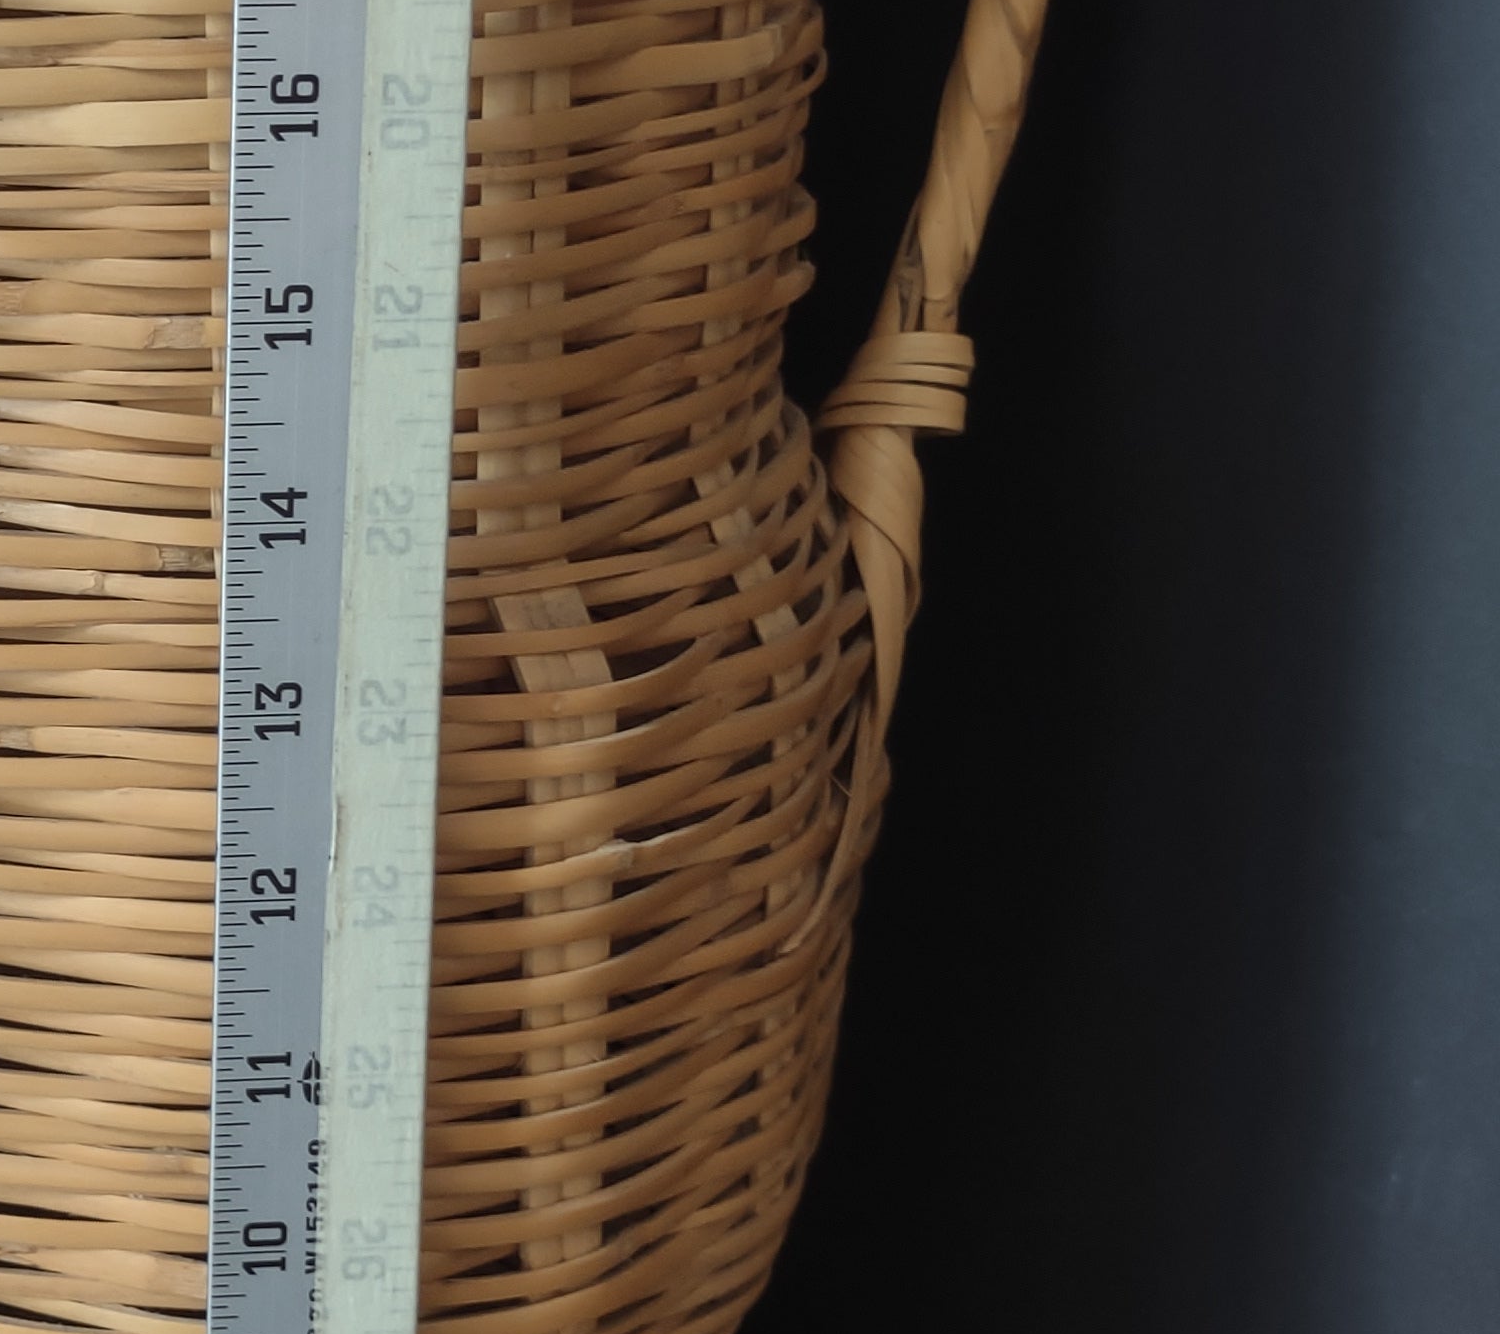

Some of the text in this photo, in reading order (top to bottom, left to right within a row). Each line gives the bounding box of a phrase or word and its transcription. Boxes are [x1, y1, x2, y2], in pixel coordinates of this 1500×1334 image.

[269, 73, 319, 141] 16
[381, 76, 432, 150] 20
[264, 284, 313, 350] 15
[373, 284, 424, 353] 21
[258, 486, 308, 549] 14
[366, 485, 414, 557] 22
[254, 681, 302, 740] 13
[358, 678, 407, 747] 23
[250, 867, 297, 925] 12
[353, 865, 398, 930] 24
[246, 1050, 292, 1104] 11
[347, 1045, 391, 1112] 25
[242, 1220, 287, 1276] 10
[341, 1217, 387, 1282] 26
